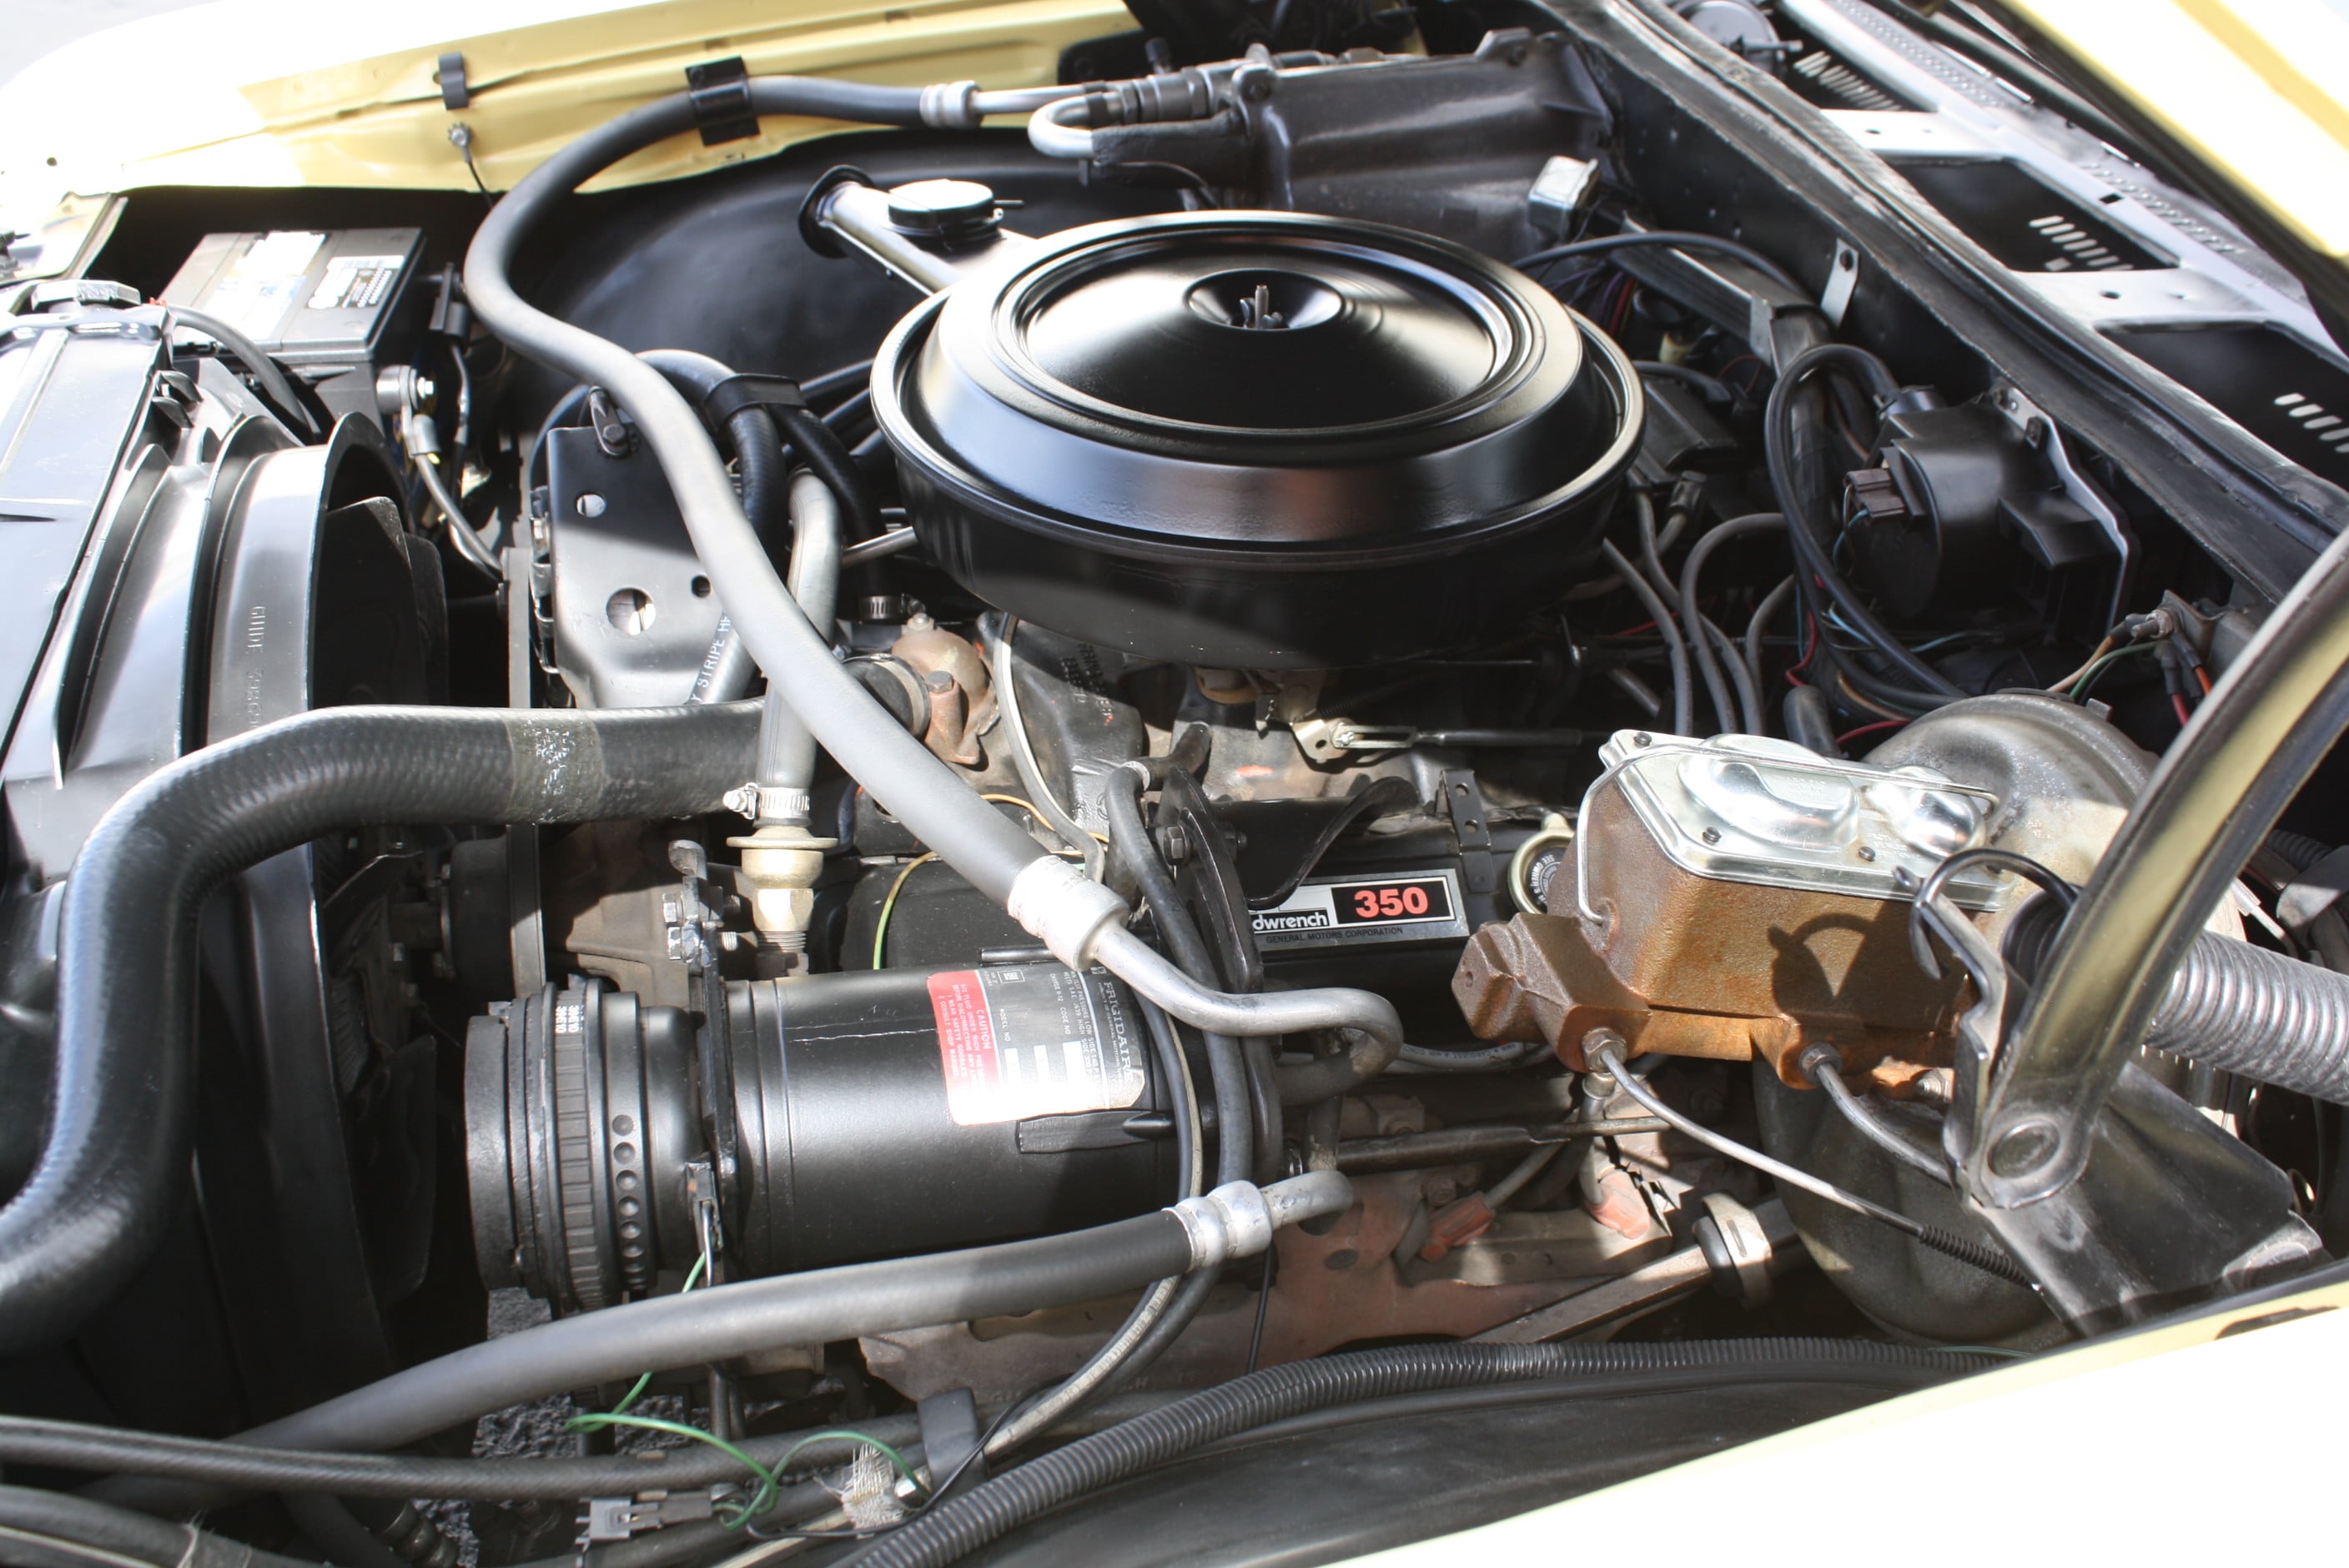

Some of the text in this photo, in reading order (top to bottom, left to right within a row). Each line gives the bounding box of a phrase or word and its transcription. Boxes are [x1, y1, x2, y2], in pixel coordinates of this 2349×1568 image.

[1354, 887, 1429, 918] 350
[1252, 912, 1329, 931] dwrench
[1266, 927, 1403, 944] GENERAL MOTORS CORPORATION
[999, 1008, 1011, 1041] MODEL NO
[1060, 1007, 1069, 1023] CODE
[976, 1009, 992, 1049] CAUTION
[1064, 1025, 1071, 1034] NO
[1104, 982, 1134, 1083] FRIGIDAIRE
